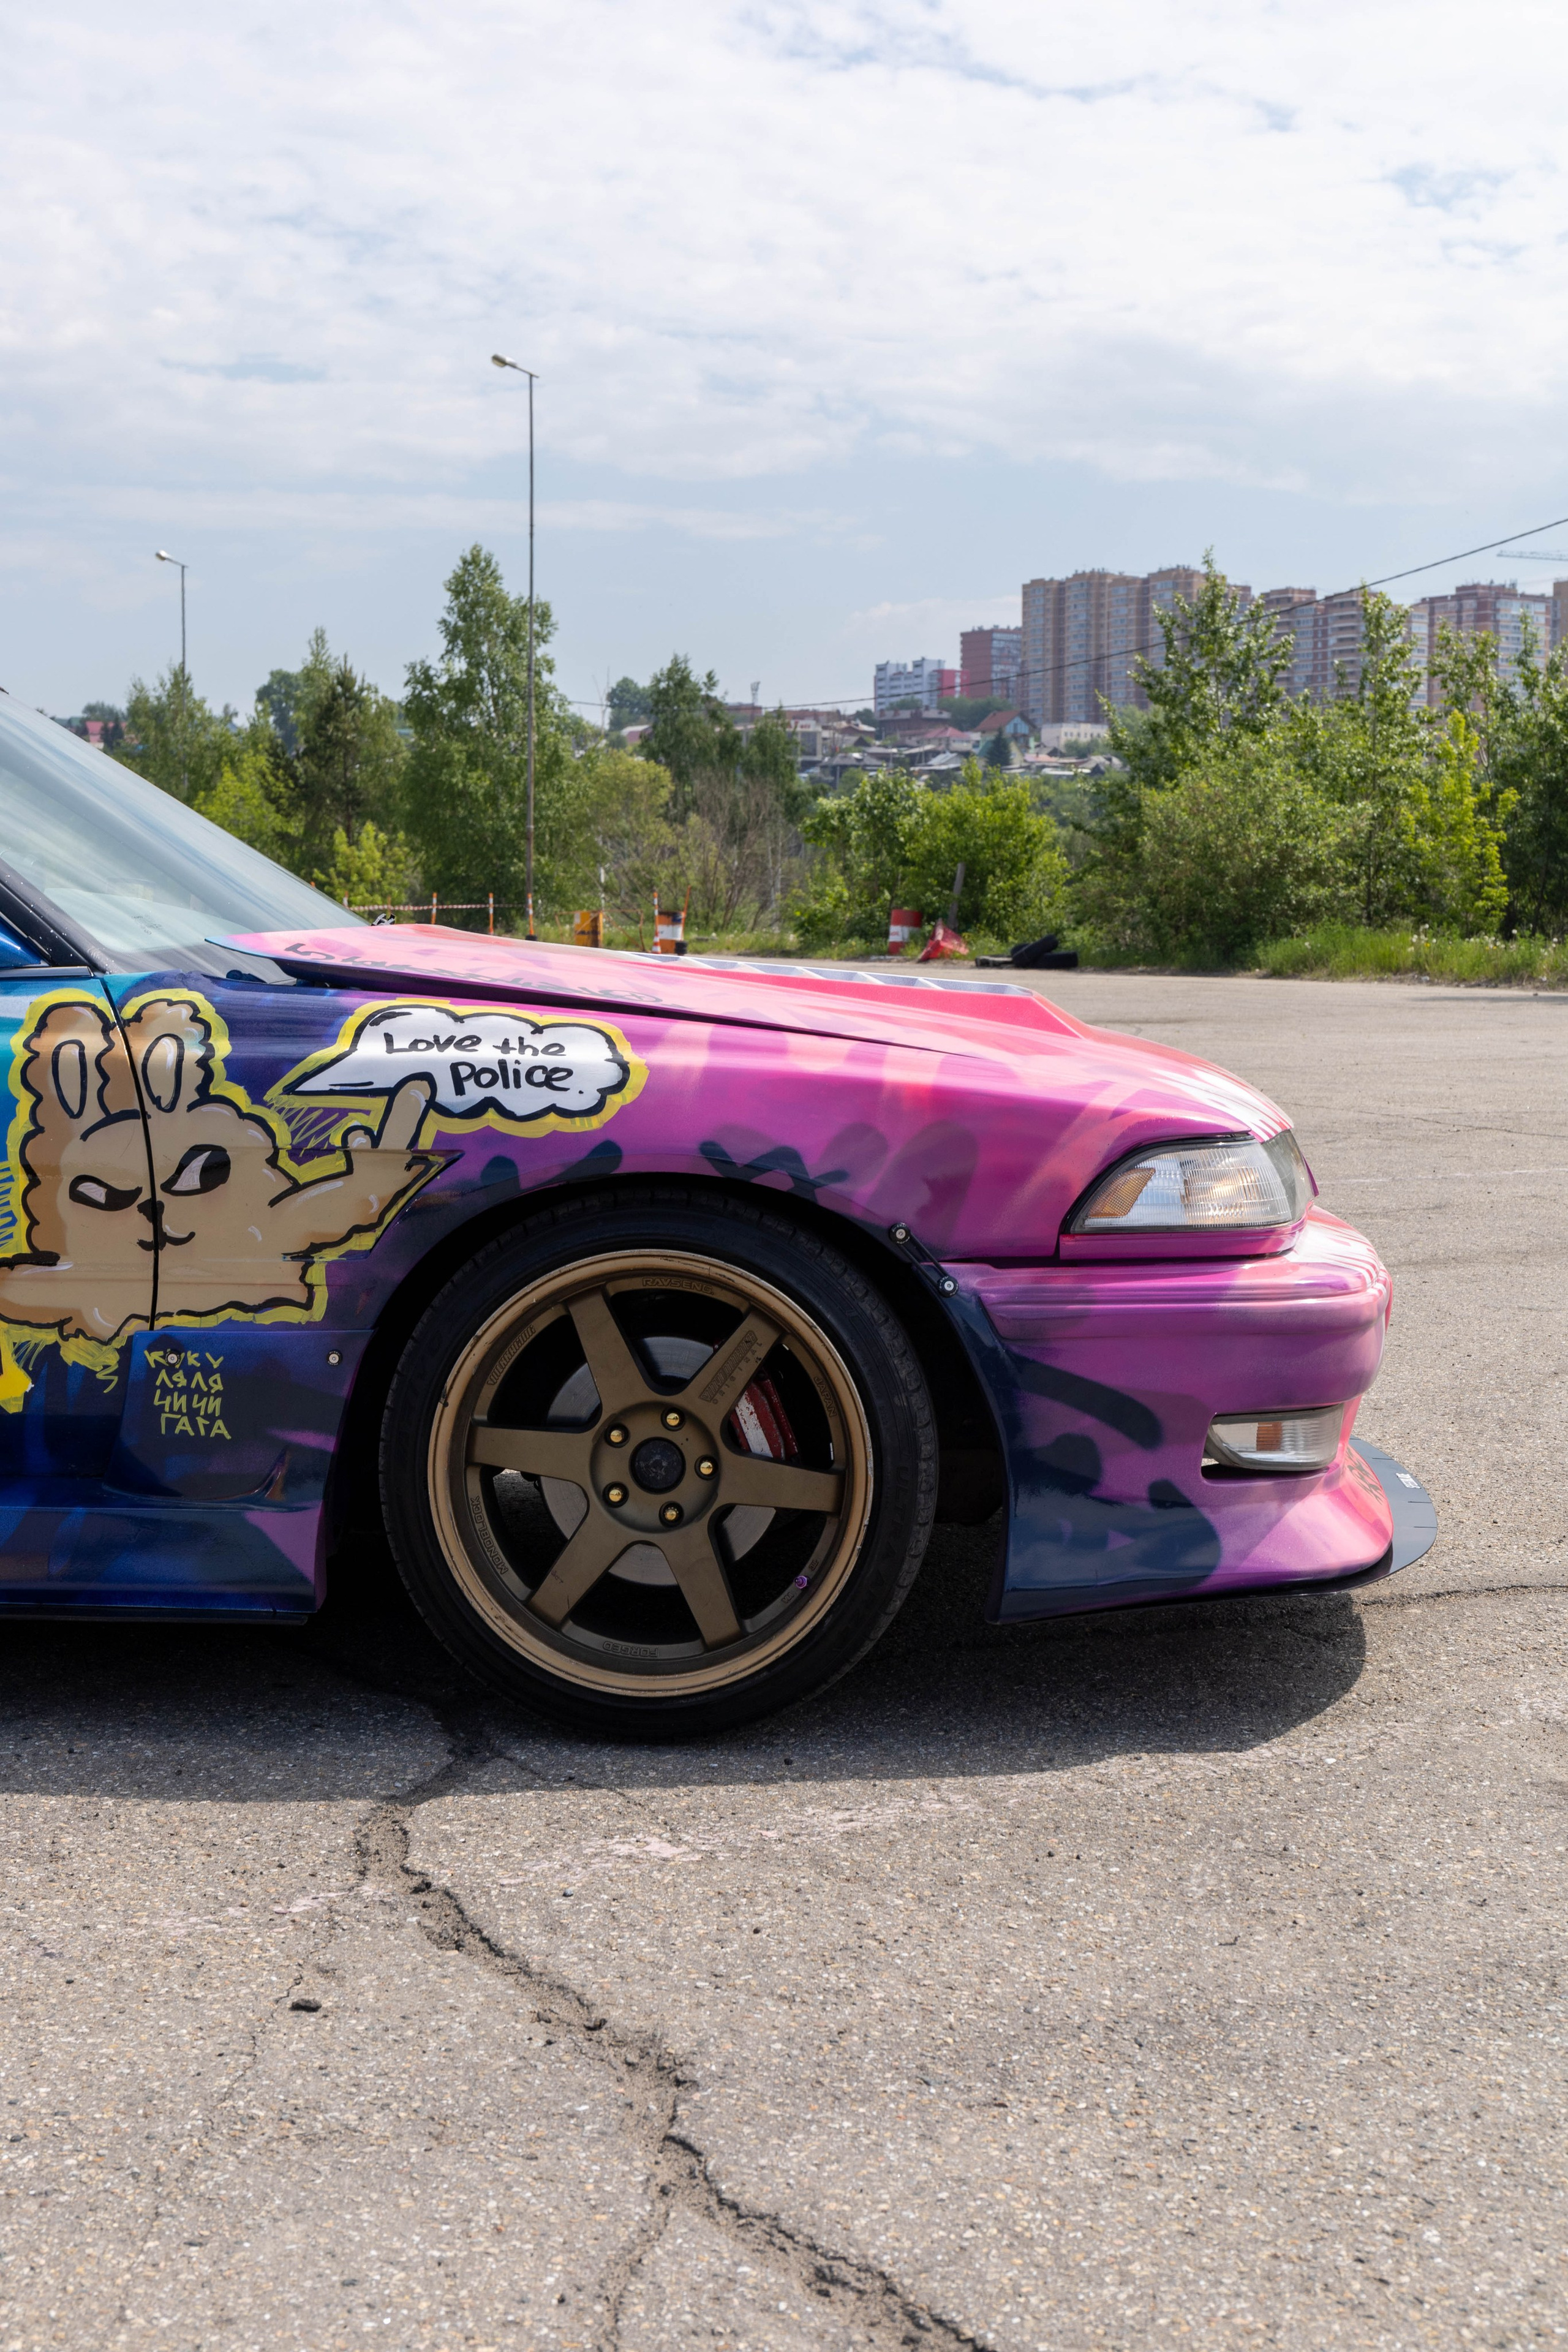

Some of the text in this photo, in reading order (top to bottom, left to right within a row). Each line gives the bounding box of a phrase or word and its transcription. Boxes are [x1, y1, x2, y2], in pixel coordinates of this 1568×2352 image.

[383, 1033, 566, 1056] Love the
[813, 1376, 838, 1417] JAPAN
[470, 1495, 509, 1575] MONOBLOCK
[602, 1640, 659, 1657] FORGED
